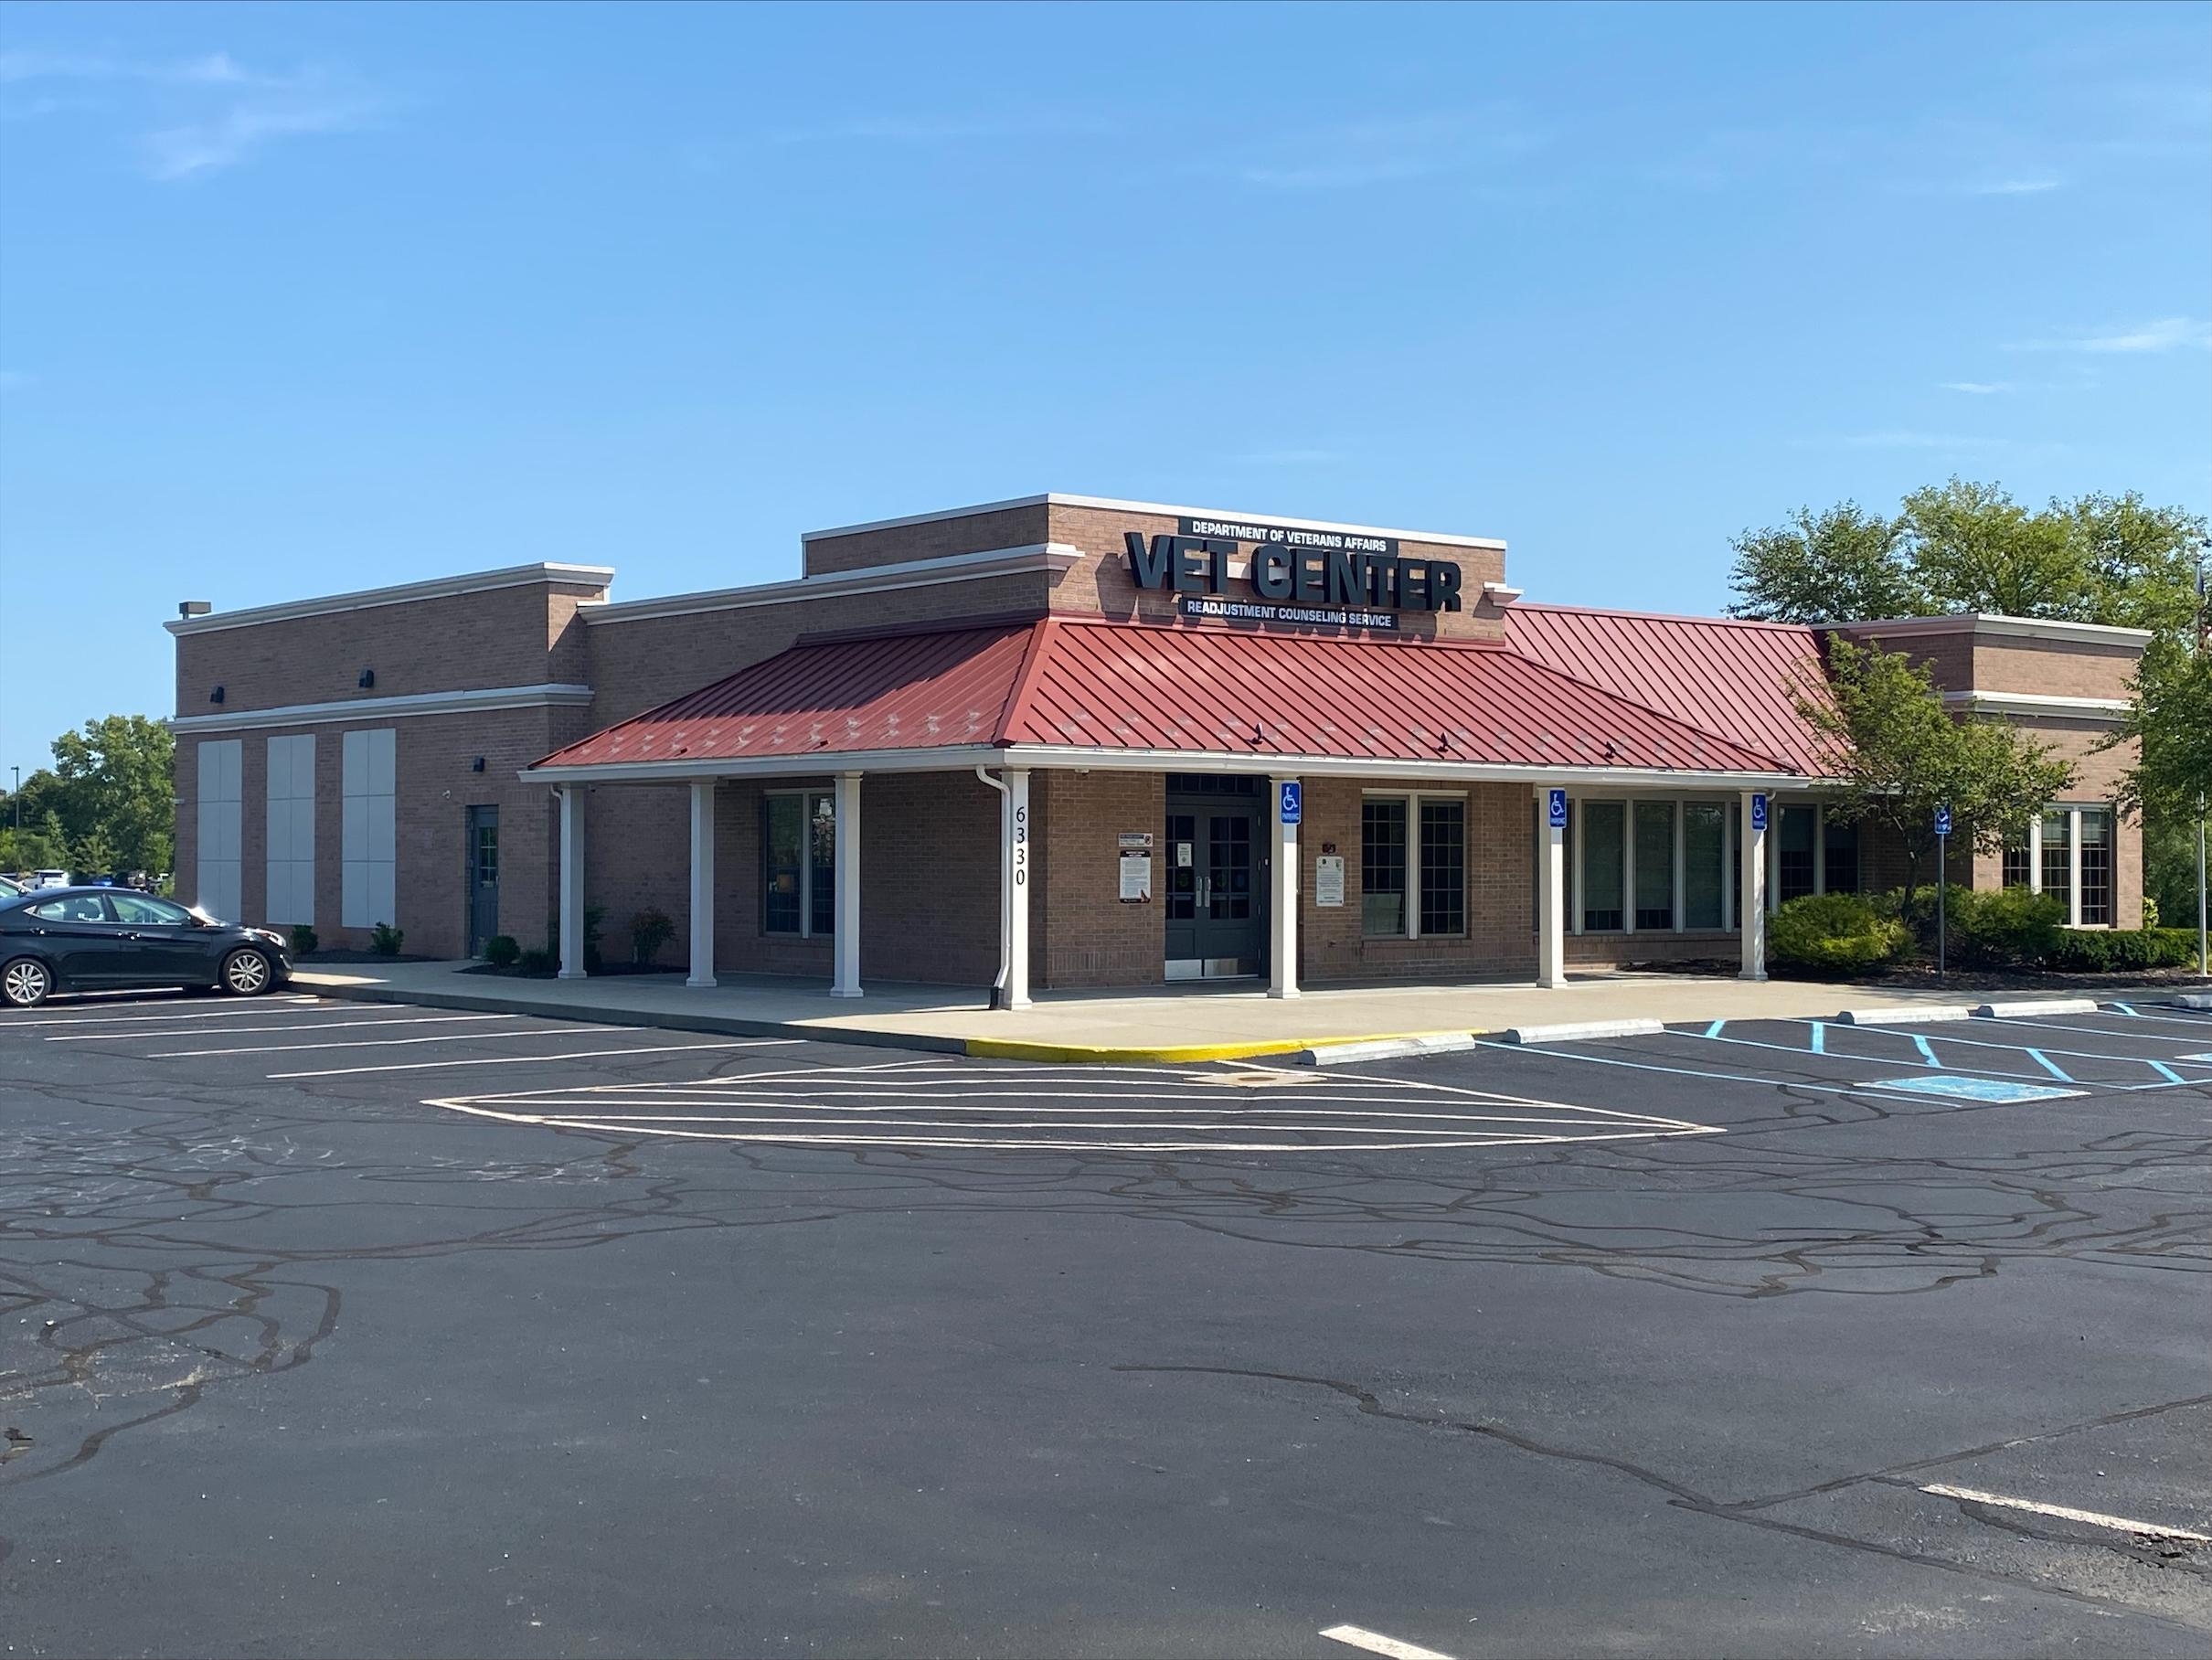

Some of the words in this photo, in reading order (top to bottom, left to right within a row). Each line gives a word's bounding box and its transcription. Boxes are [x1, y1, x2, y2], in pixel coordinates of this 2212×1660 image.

[1192, 520, 1268, 541] DEPARTMENT
[1270, 529, 1284, 542] OF
[1286, 530, 1342, 548] VETERANS
[1344, 537, 1387, 552] AFFAIRS
[1123, 531, 1239, 594] VET
[1250, 544, 1462, 612] CENTER
[1187, 600, 1277, 619] READJUSTMENT
[1278, 607, 1346, 624] COUNSELING
[1348, 613, 1392, 627] SERVICE
[1016, 806, 1026, 886] 6330
